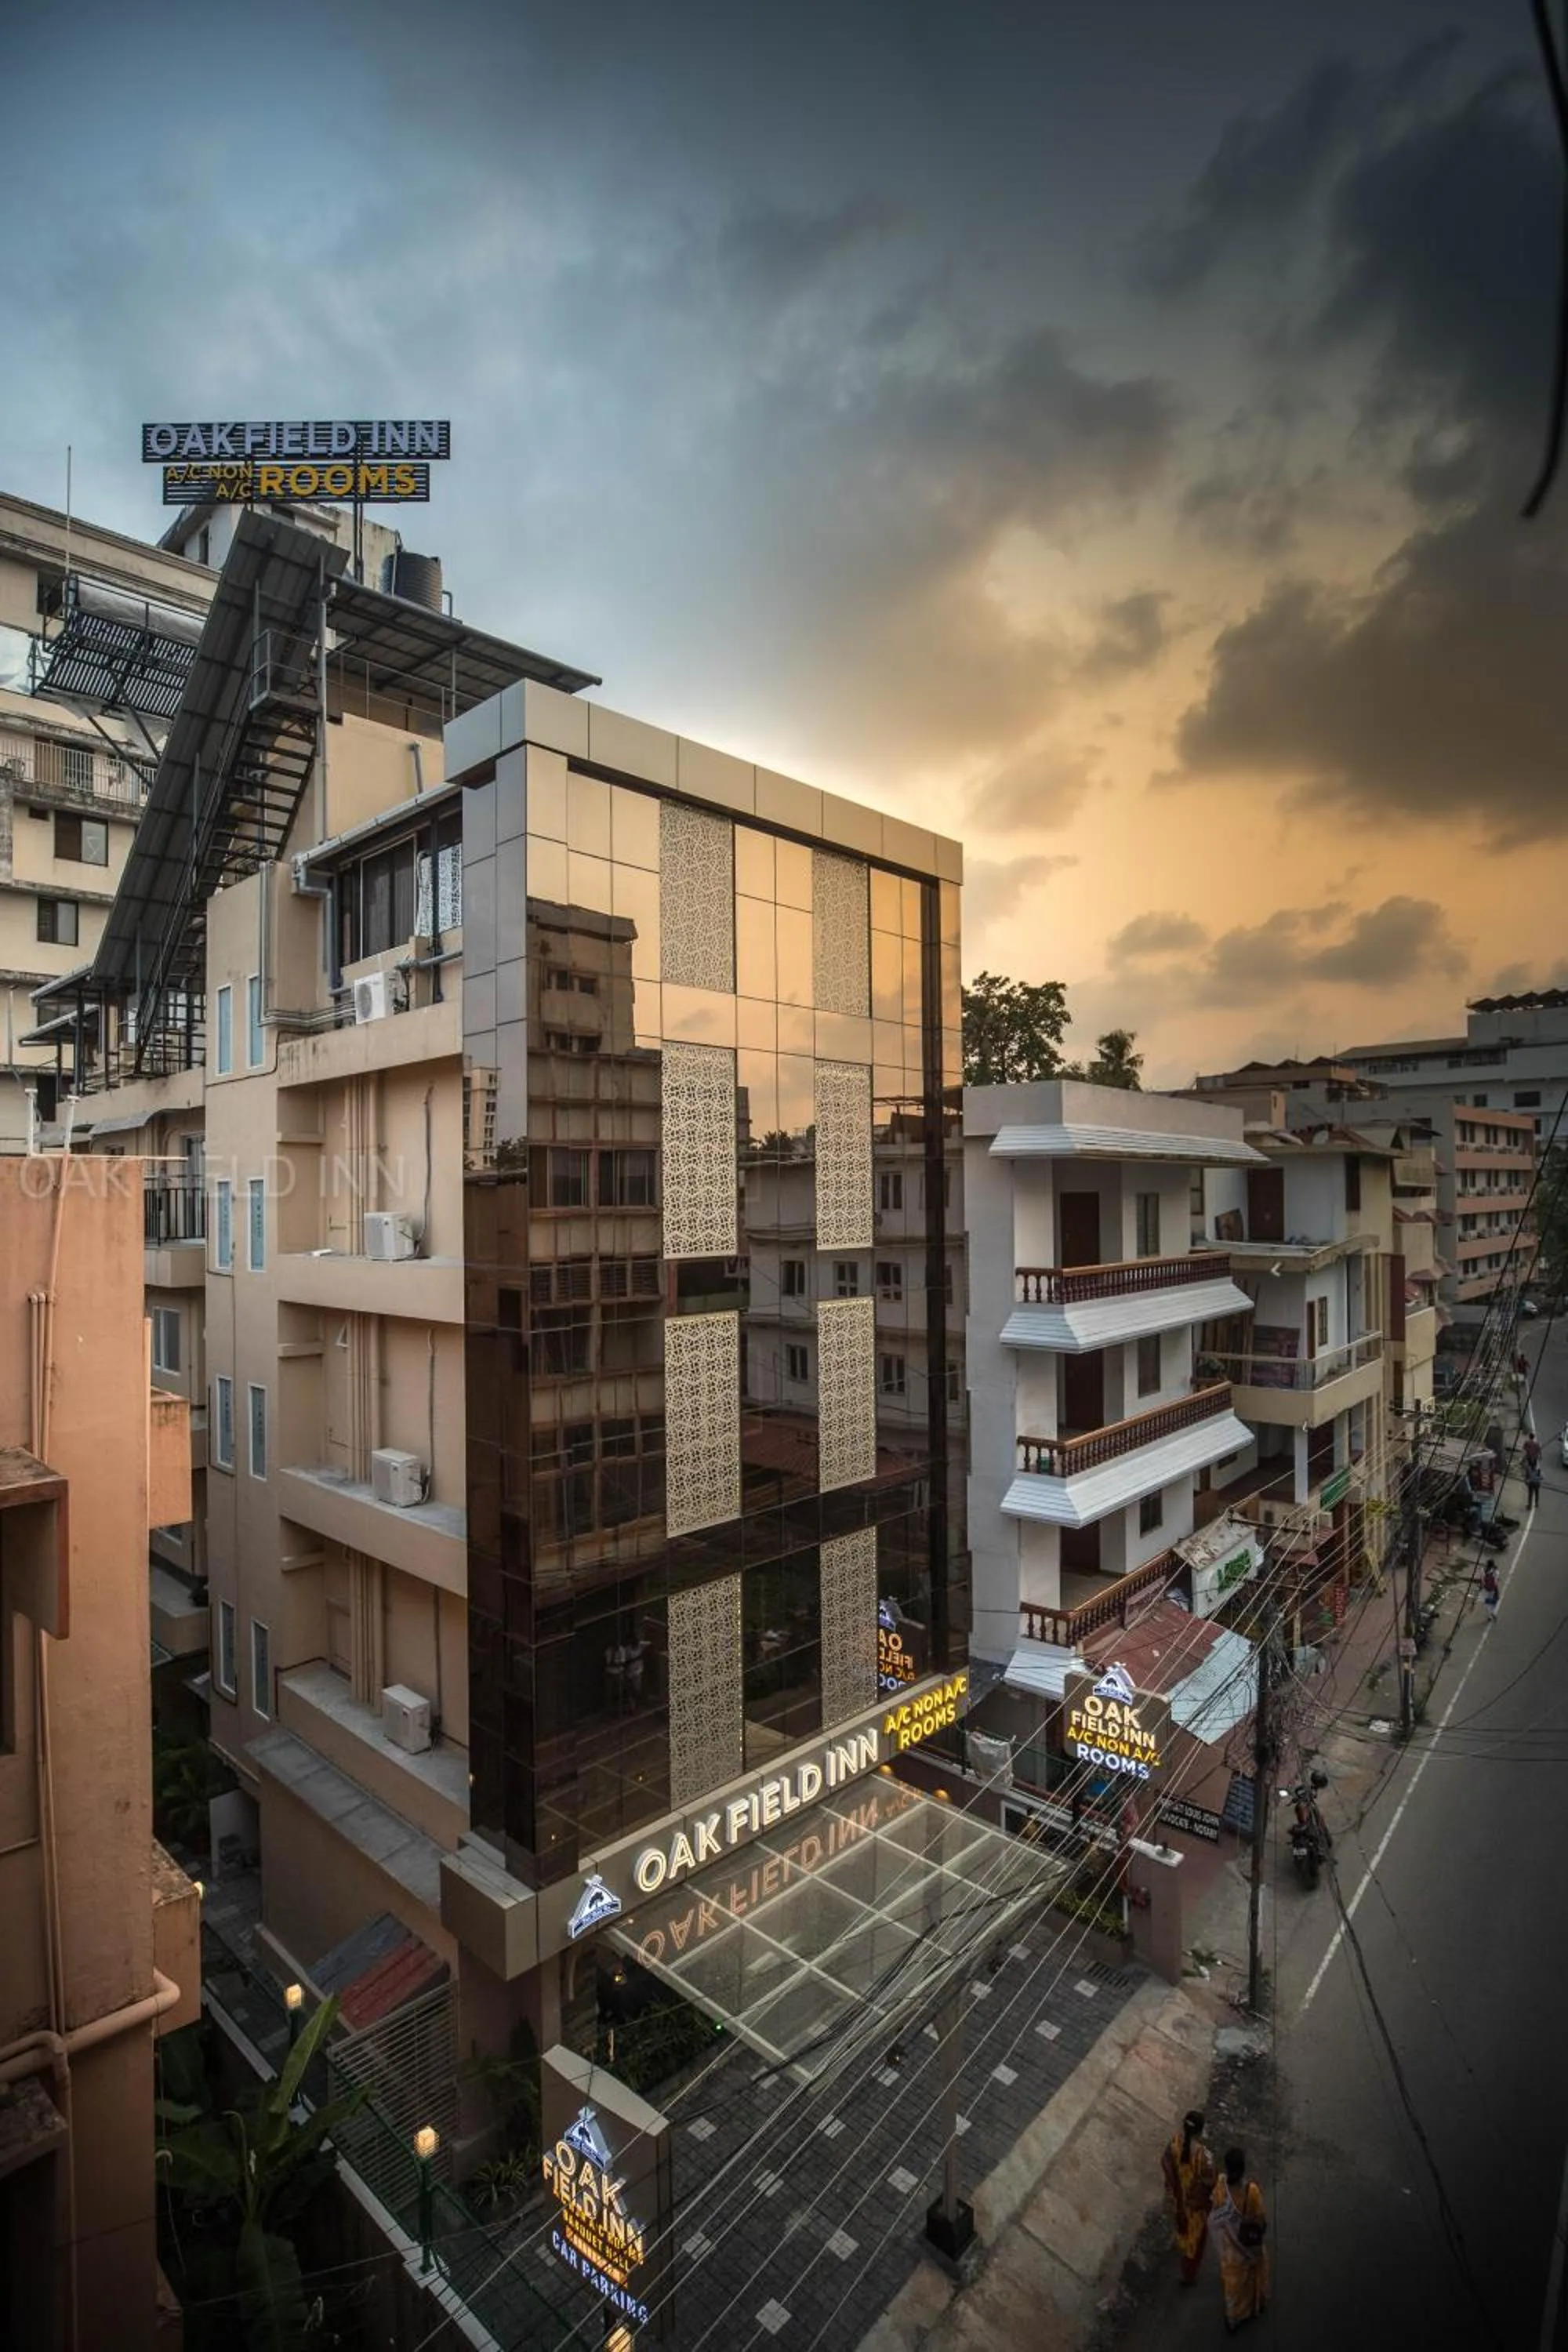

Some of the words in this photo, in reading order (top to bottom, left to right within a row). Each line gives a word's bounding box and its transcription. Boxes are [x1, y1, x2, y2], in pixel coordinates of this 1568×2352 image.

[150, 423, 236, 456] OAK
[244, 422, 357, 455] FIELD
[372, 421, 439, 453] INN
[167, 463, 201, 483] A/C
[209, 465, 252, 479] NON
[260, 464, 417, 497] ROOMS
[884, 1706, 912, 1733] A/C
[912, 1686, 942, 1719] NON
[944, 1675, 967, 1705] A/C
[1084, 1695, 1142, 1730] OAK
[898, 1702, 956, 1750] ROOMS
[1067, 1726, 1093, 1745] A/C
[1097, 1733, 1129, 1758] NON
[1071, 1710, 1121, 1738] FIELD
[1123, 1726, 1156, 1751] INN
[1076, 1743, 1152, 1780] ROOMS
[633, 1813, 721, 1893] OAK
[726, 1762, 822, 1844] FIELD
[826, 1727, 879, 1787] INN
[542, 2152, 597, 2220] FIELD
[556, 2140, 626, 2216] OAK
[552, 2230, 578, 2270] CAR
[582, 2258, 649, 2325] PARKING
